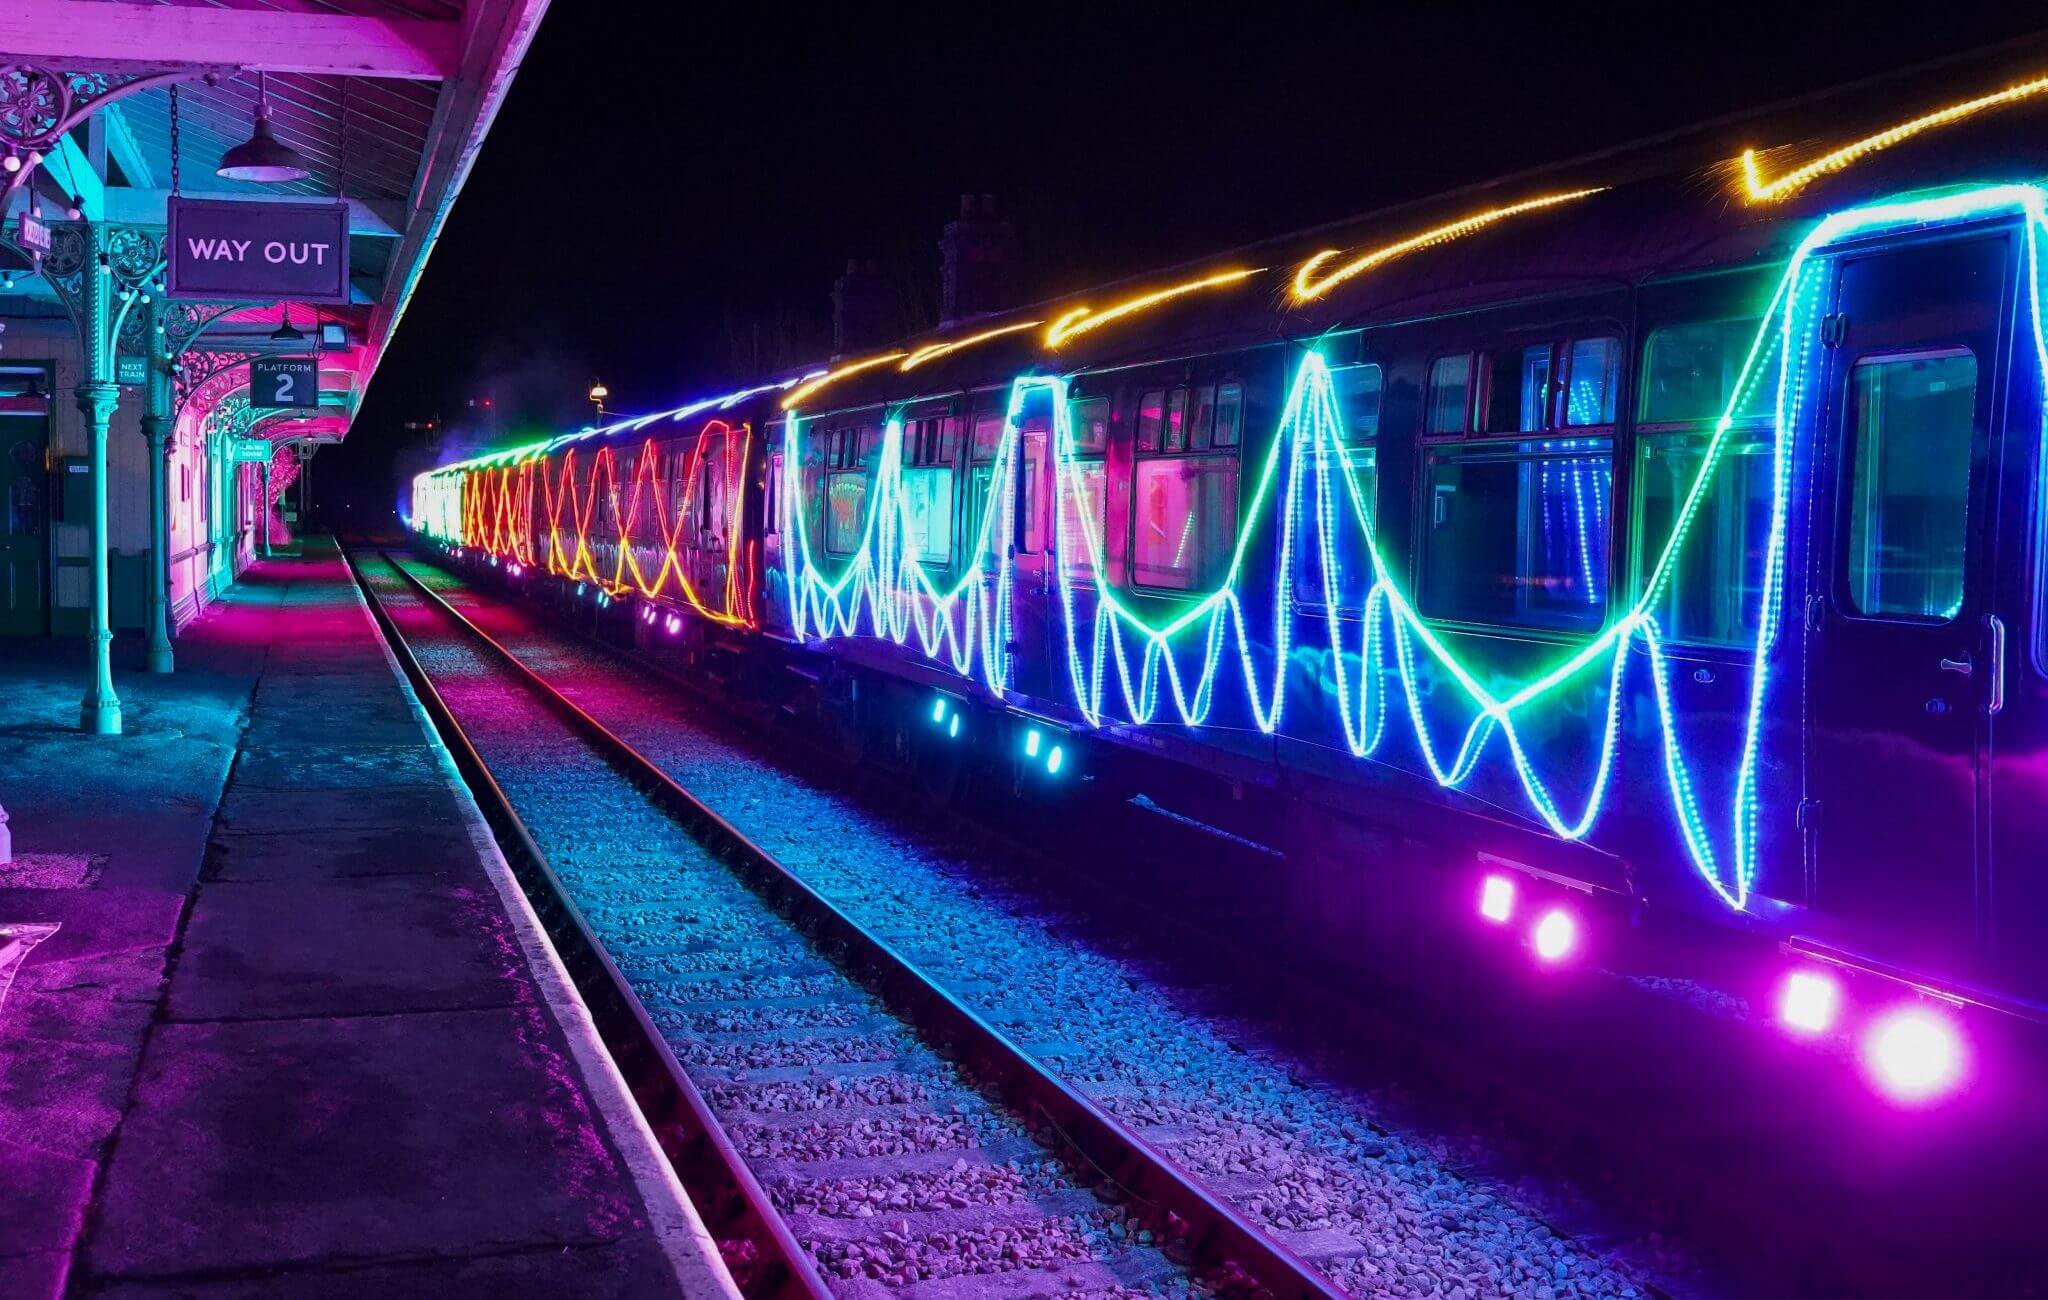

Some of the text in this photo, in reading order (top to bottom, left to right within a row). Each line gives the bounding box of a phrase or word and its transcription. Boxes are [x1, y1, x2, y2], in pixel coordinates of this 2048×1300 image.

[188, 238, 330, 265] WAY OUT
[257, 363, 311, 372] PLATFORM
[275, 373, 294, 402] 2
